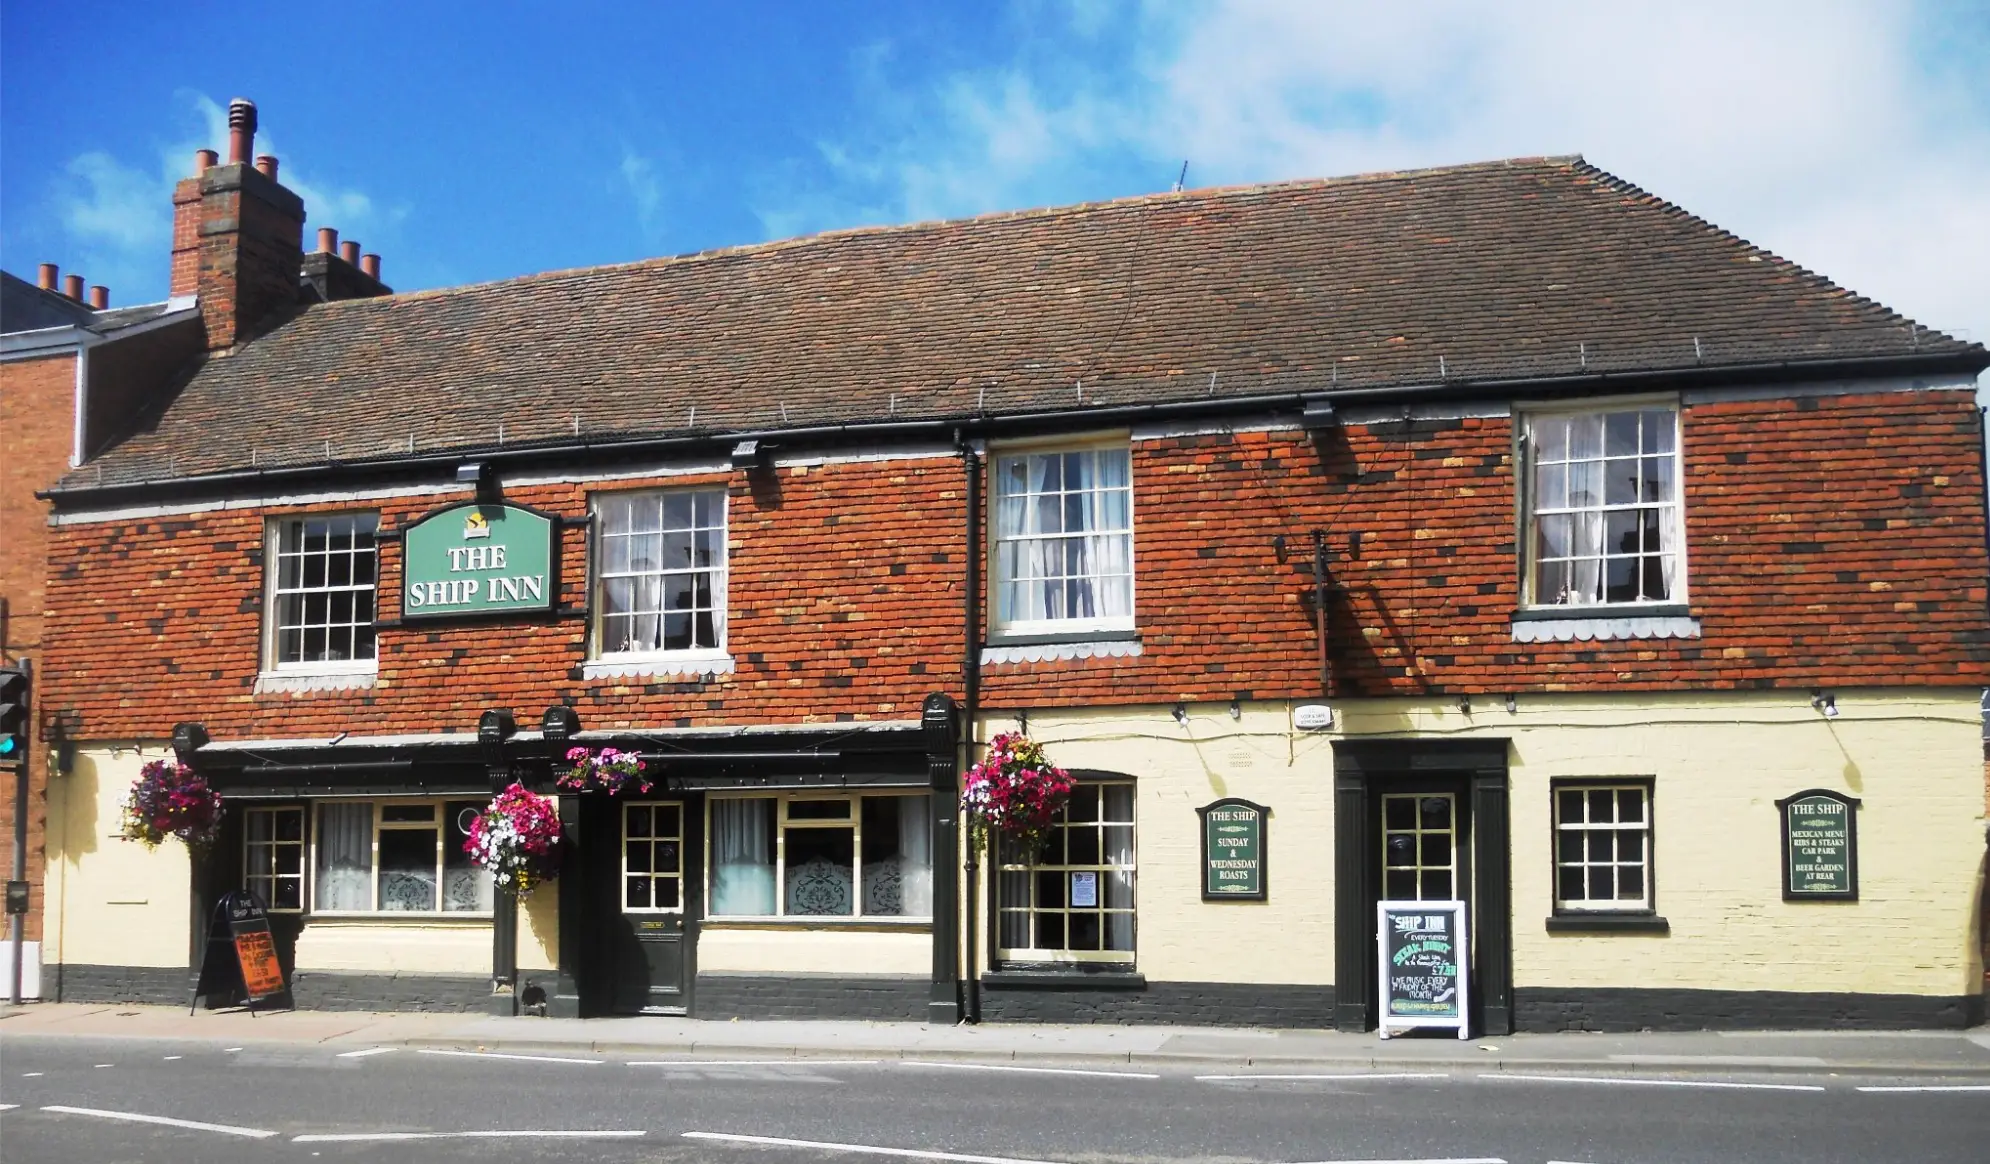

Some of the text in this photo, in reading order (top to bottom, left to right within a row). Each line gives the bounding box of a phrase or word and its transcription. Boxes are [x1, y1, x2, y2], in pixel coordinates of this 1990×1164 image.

[448, 545, 507, 571] THE
[410, 575, 543, 607] SHIP INN
[1793, 804, 1843, 815] THE SHIP
[1211, 811, 1255, 821] THE SHIP
[1792, 830, 1845, 838] MEXICAN MENU
[1218, 837, 1249, 847] SUNDAY
[1794, 838, 1844, 846] RIBS & STEAKS
[1230, 848, 1237, 858] &
[1802, 847, 1836, 855] CAR PARK
[1210, 860, 1257, 869] WEDNESDAY
[1795, 864, 1844, 872] BEER GARDEN
[1219, 870, 1248, 880] ROASTS
[1805, 872, 1834, 880] AT REAR
[233, 909, 248, 917] SHIP
[1395, 916, 1422, 930] SHIP
[1425, 916, 1445, 930] INN
[1392, 976, 1448, 986] LIVE MUSIC EVERY
[1399, 983, 1419, 992] FRIDAY
[1420, 983, 1429, 991] OF
[1431, 983, 1445, 992] THE
[1409, 990, 1432, 999] MONTH
